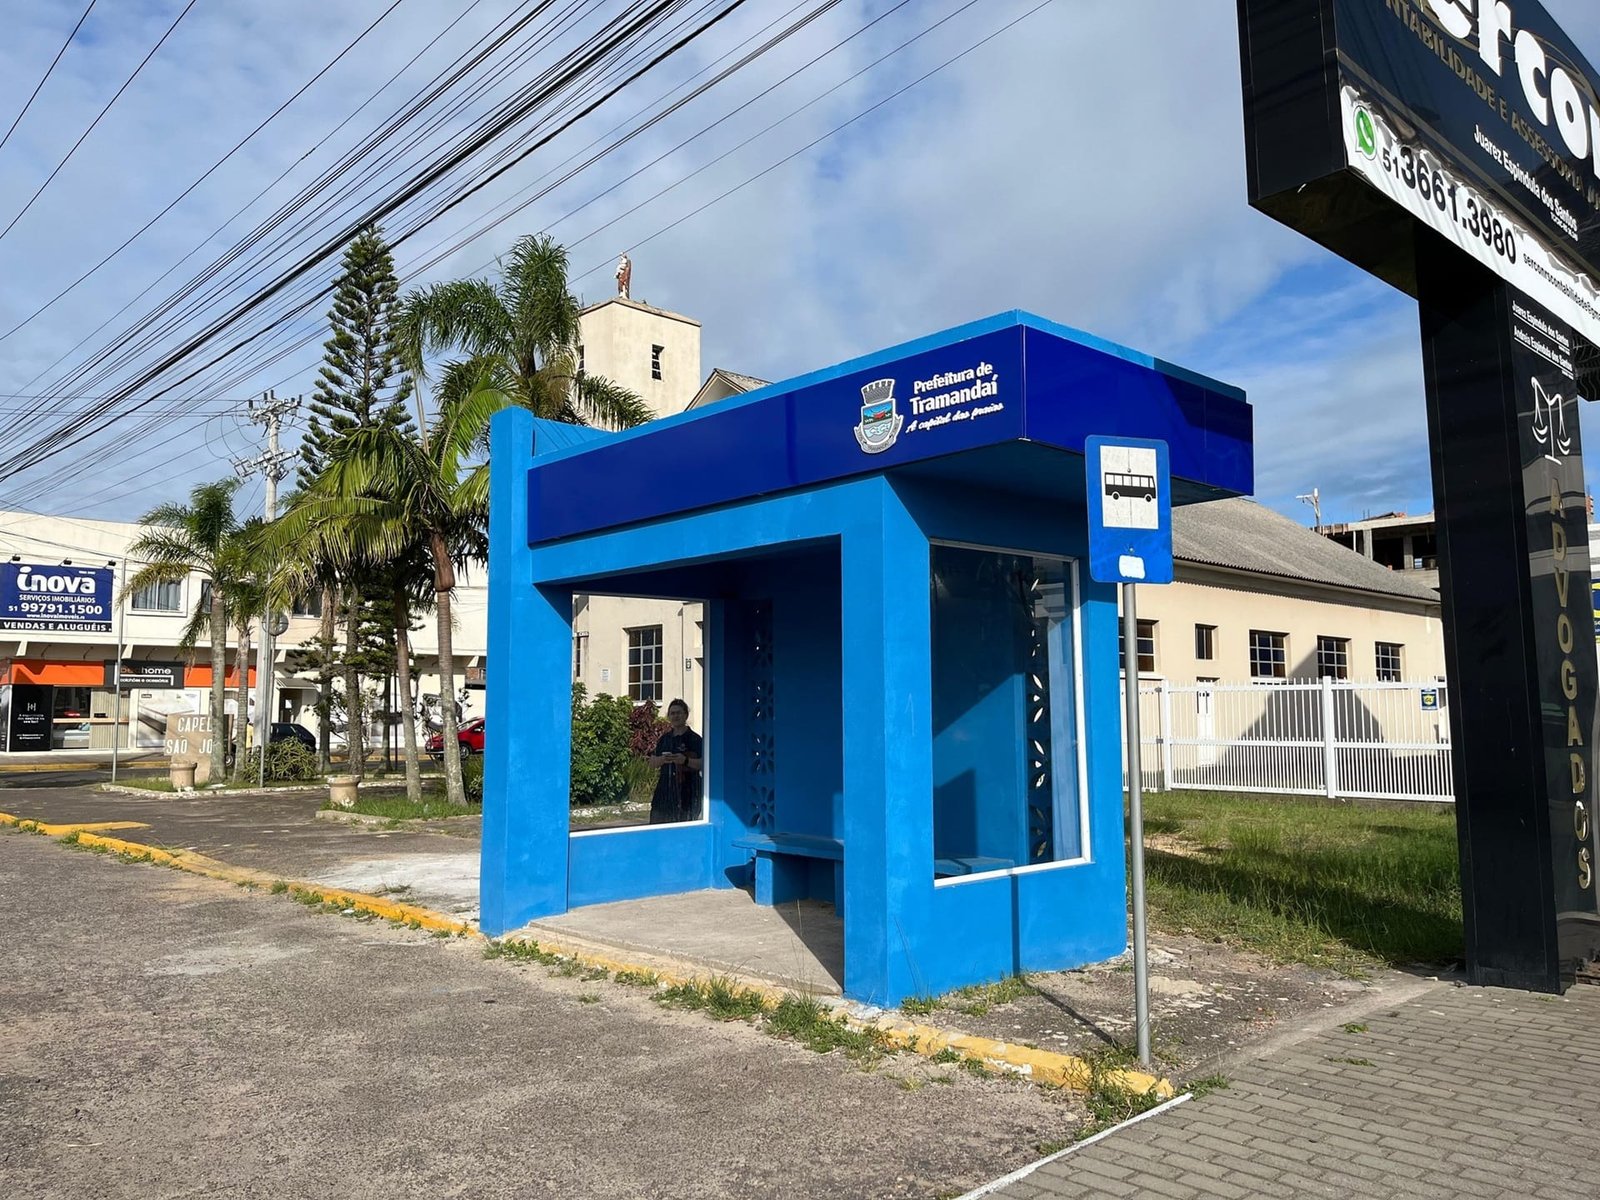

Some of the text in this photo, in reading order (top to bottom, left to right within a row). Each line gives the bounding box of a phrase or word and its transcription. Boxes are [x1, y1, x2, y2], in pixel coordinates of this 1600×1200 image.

[1500, 100, 1509, 123] E
[1473, 123, 1503, 166] Juarez
[1541, 186, 1554, 211] dos
[1554, 198, 1578, 232] Santos
[1382, 146, 1517, 265] 51 3661.3980
[913, 361, 994, 395] Prefeitura de
[909, 373, 998, 416] Tramandaí
[905, 402, 1005, 434] A capital das praias
[17, 566, 96, 594] inova
[19, 594, 96, 604] SERVIÇOS IMOBILIÁRIOS
[20, 602, 103, 615] 99791.1500
[3, 621, 46, 630] VENDAS
[48, 622, 55, 630] E
[1550, 477, 1592, 891] ADVOGADOS
